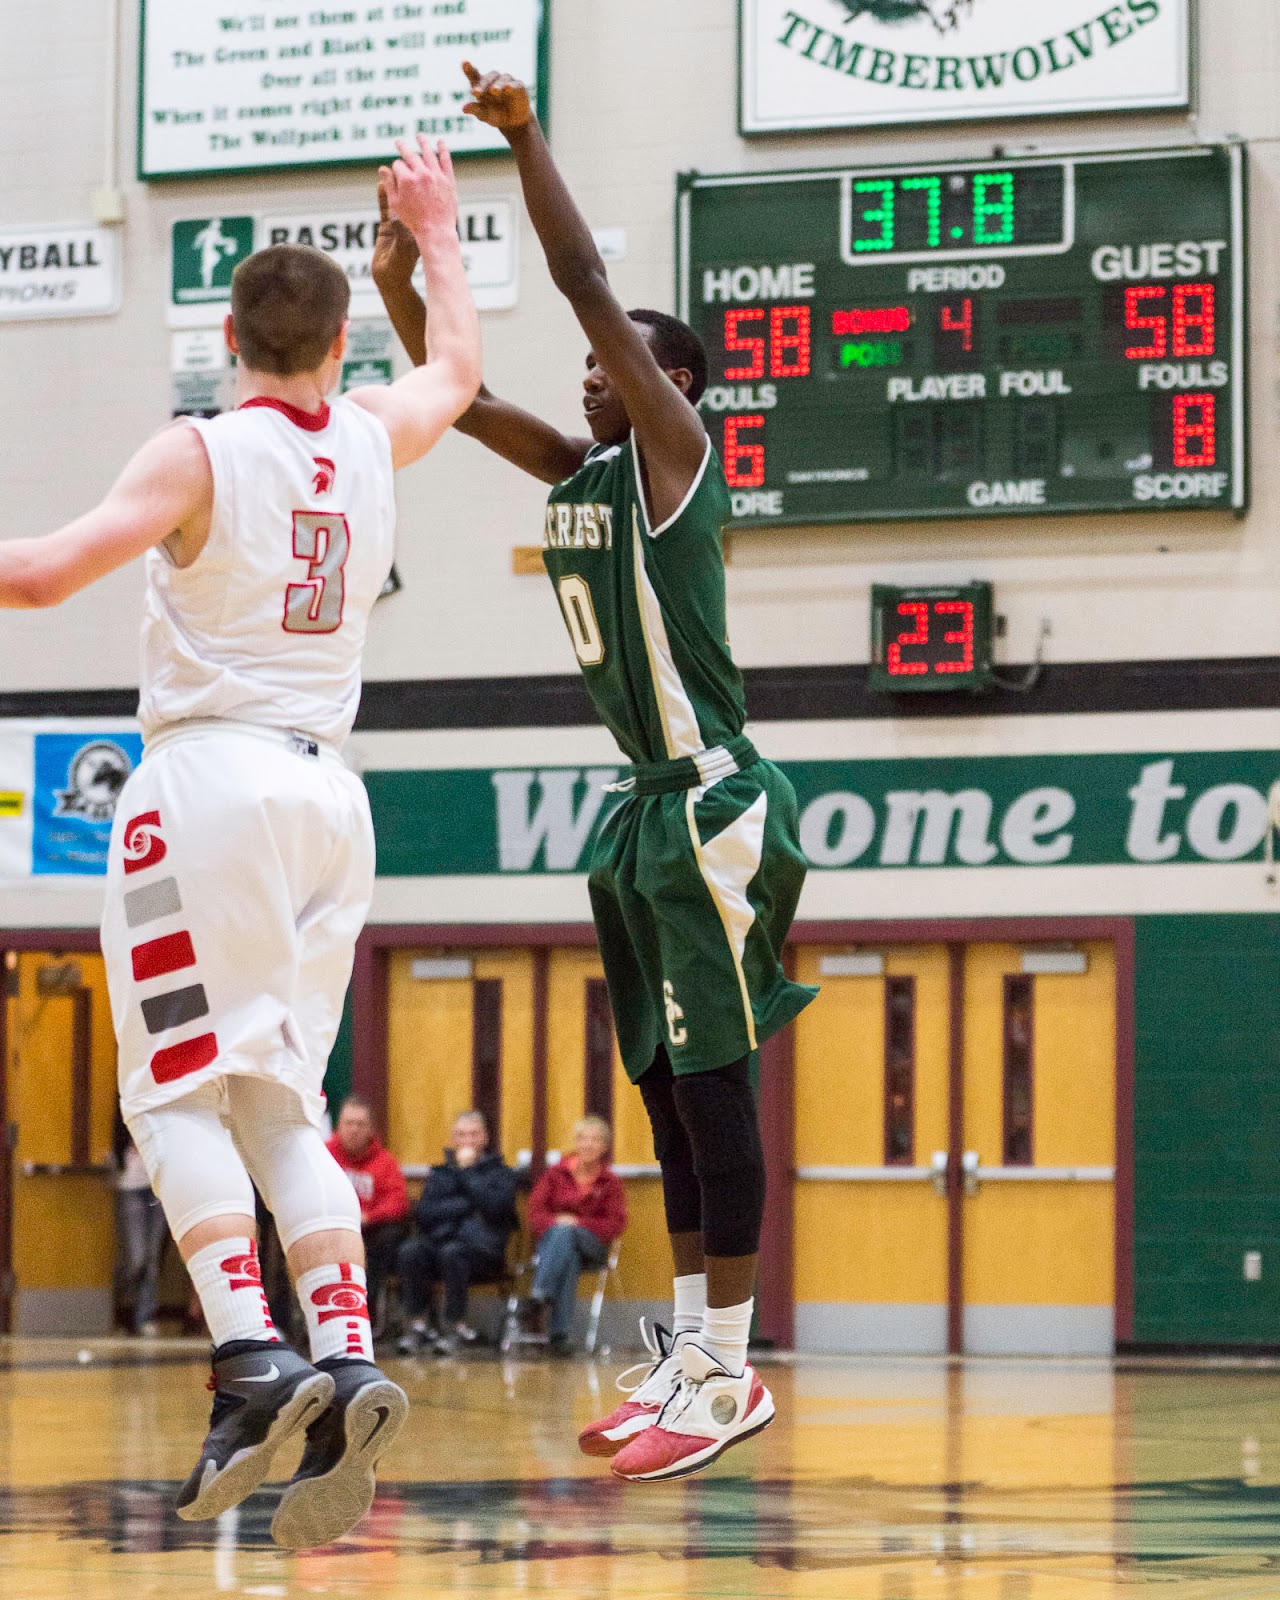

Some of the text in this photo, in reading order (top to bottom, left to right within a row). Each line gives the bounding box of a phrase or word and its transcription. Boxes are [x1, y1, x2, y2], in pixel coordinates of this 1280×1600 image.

[308, 10, 355, 26] them
[393, 4, 423, 19] the
[433, 1, 465, 15] end
[172, 29, 511, 68] The Green and Black will conquer
[777, 0, 1160, 91] TIMBERWOLVES
[152, 107, 204, 124] When
[237, 103, 293, 120] comes
[302, 97, 352, 117] right
[361, 95, 414, 110] down
[208, 132, 242, 151] The
[377, 120, 405, 138] the
[854, 173, 1015, 251] 37.8
[703, 264, 815, 303] HOME
[908, 265, 1006, 293] PERIOD
[1091, 241, 1226, 281] GUEST
[724, 306, 810, 379] 58
[940, 298, 972, 351] 4
[1125, 283, 1214, 358] 58
[888, 371, 1071, 401] PLAYER FOUL
[1138, 361, 1228, 389] FOULS
[724, 415, 764, 487] 6
[1173, 394, 1214, 467] 8
[731, 490, 784, 517] ORE
[967, 479, 1046, 506] GAME
[543, 502, 613, 549] CREST
[282, 510, 350, 634] 3
[558, 574, 605, 666] 0
[888, 602, 973, 674] 23
[490, 759, 1268, 872] Wome to
